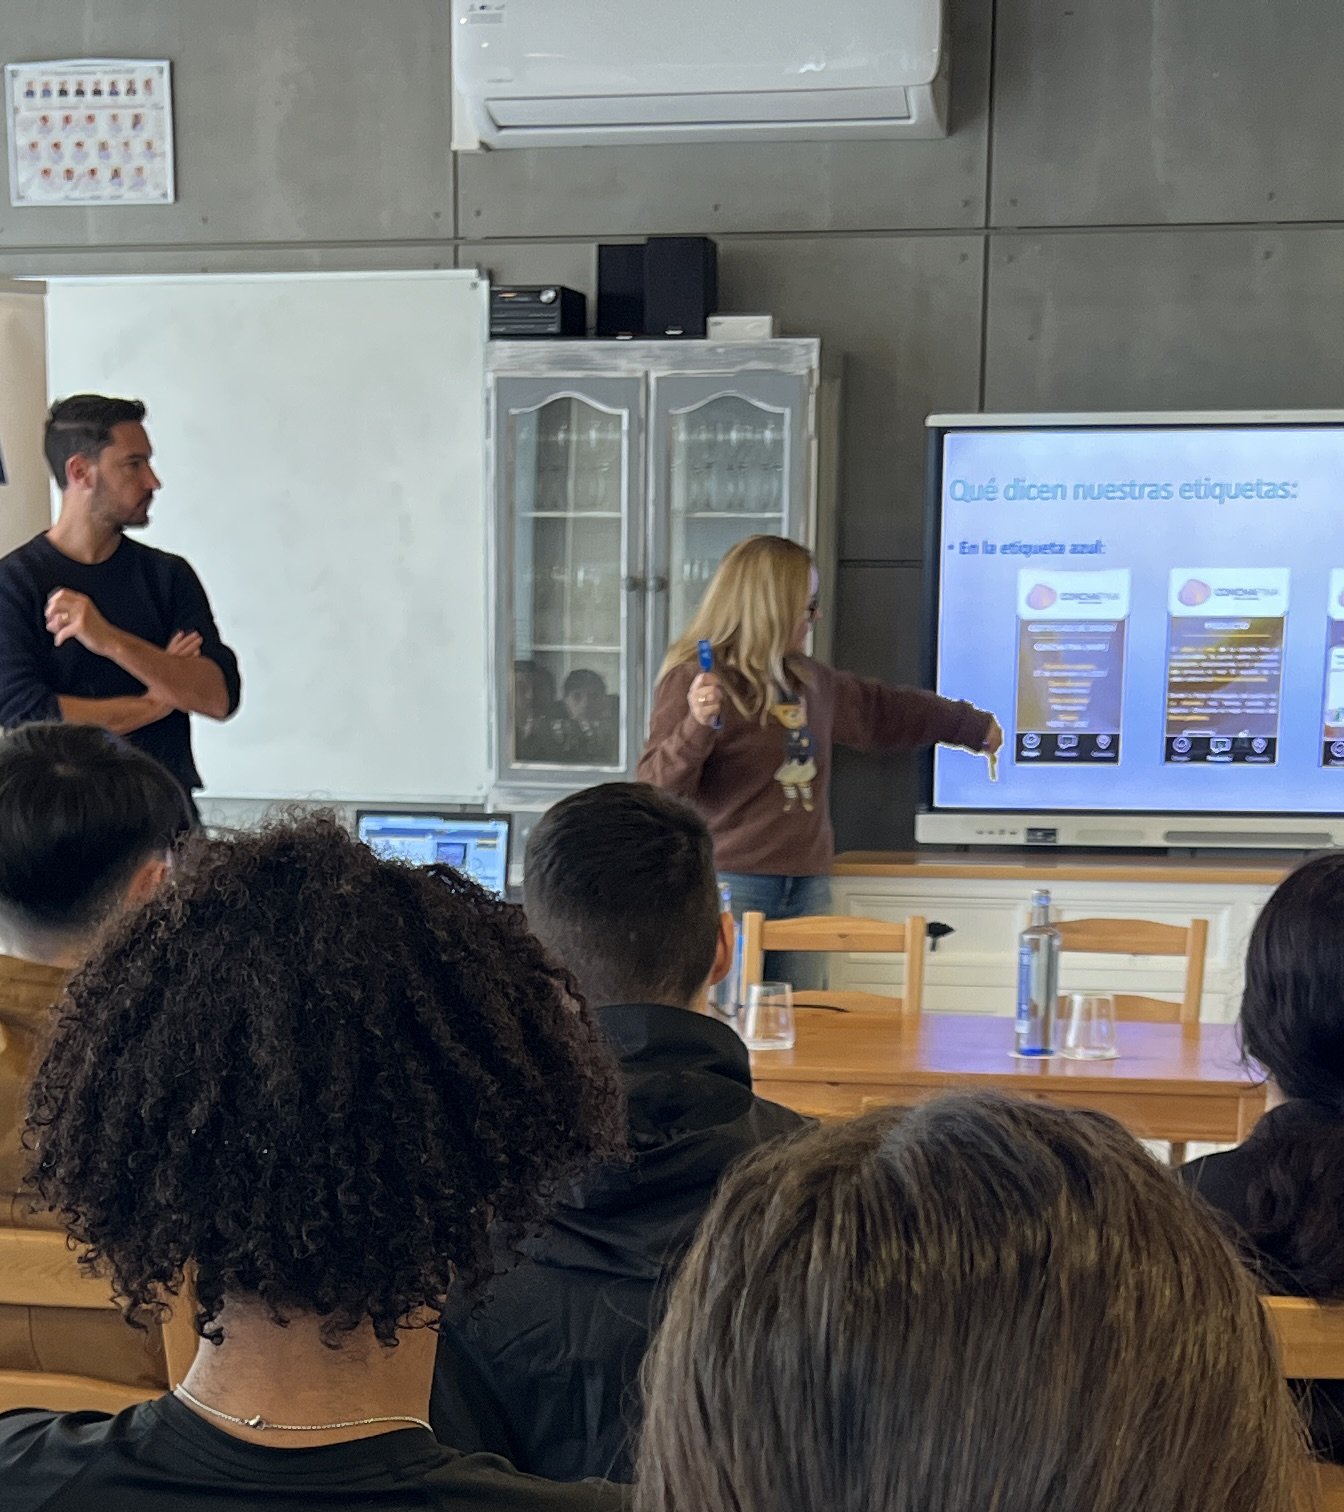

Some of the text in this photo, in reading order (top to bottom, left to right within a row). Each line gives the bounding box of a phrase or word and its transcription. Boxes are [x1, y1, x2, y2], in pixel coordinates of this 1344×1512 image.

[950, 478, 1299, 504] Qué dicen nuestras etiquetas:
